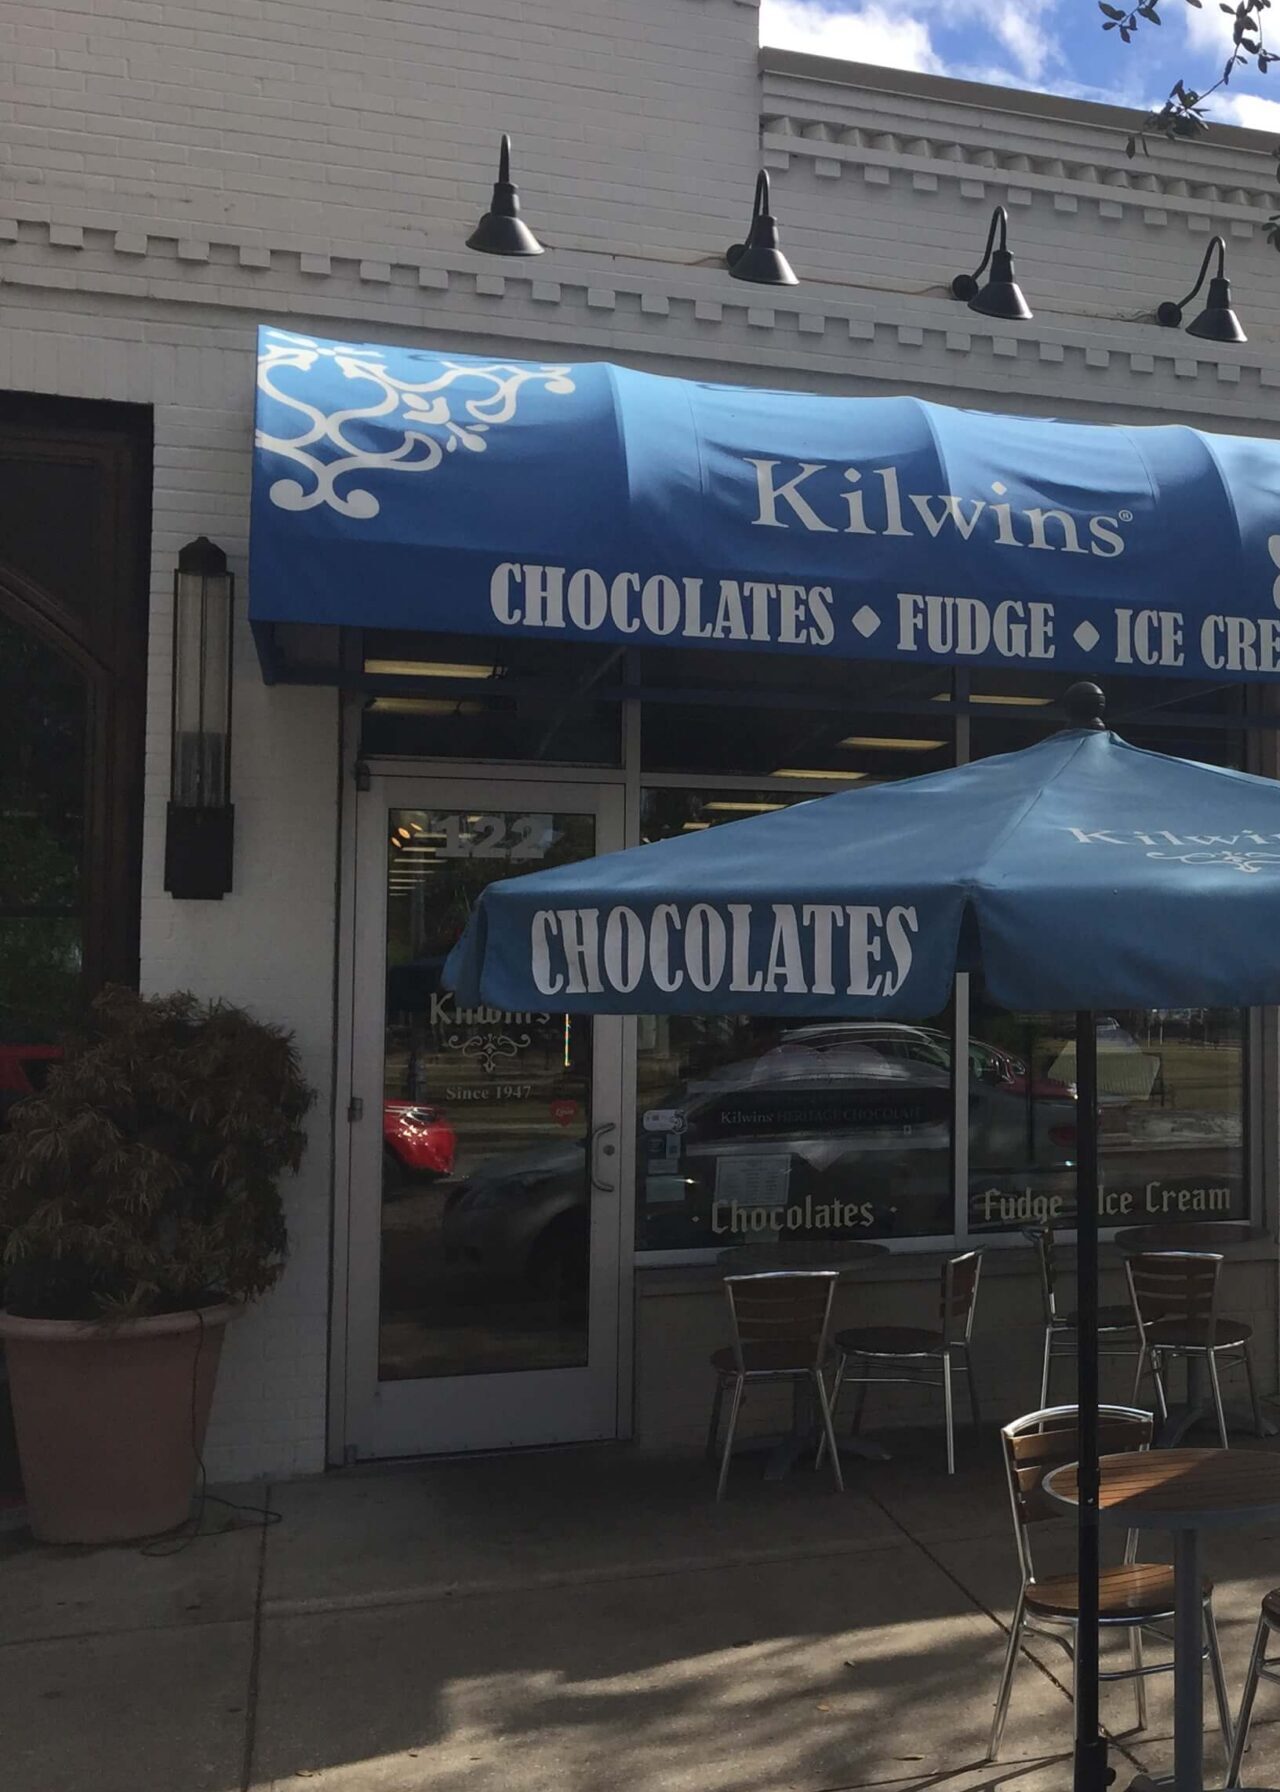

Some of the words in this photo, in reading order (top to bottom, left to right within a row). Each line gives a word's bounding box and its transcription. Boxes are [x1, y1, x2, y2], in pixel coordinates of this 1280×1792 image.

[489, 561, 836, 647] CHOCOLATES
[896, 592, 1057, 660] FUDGE
[1114, 607, 1185, 667] ICE
[432, 814, 548, 860] 122
[530, 902, 920, 997] CHOCOLATES
[446, 1085, 490, 1101] Since
[495, 1084, 533, 1101] 1947
[711, 1194, 876, 1235] Chocolates
[983, 1186, 1064, 1224] Fudge
[1145, 1181, 1231, 1213] Cream
